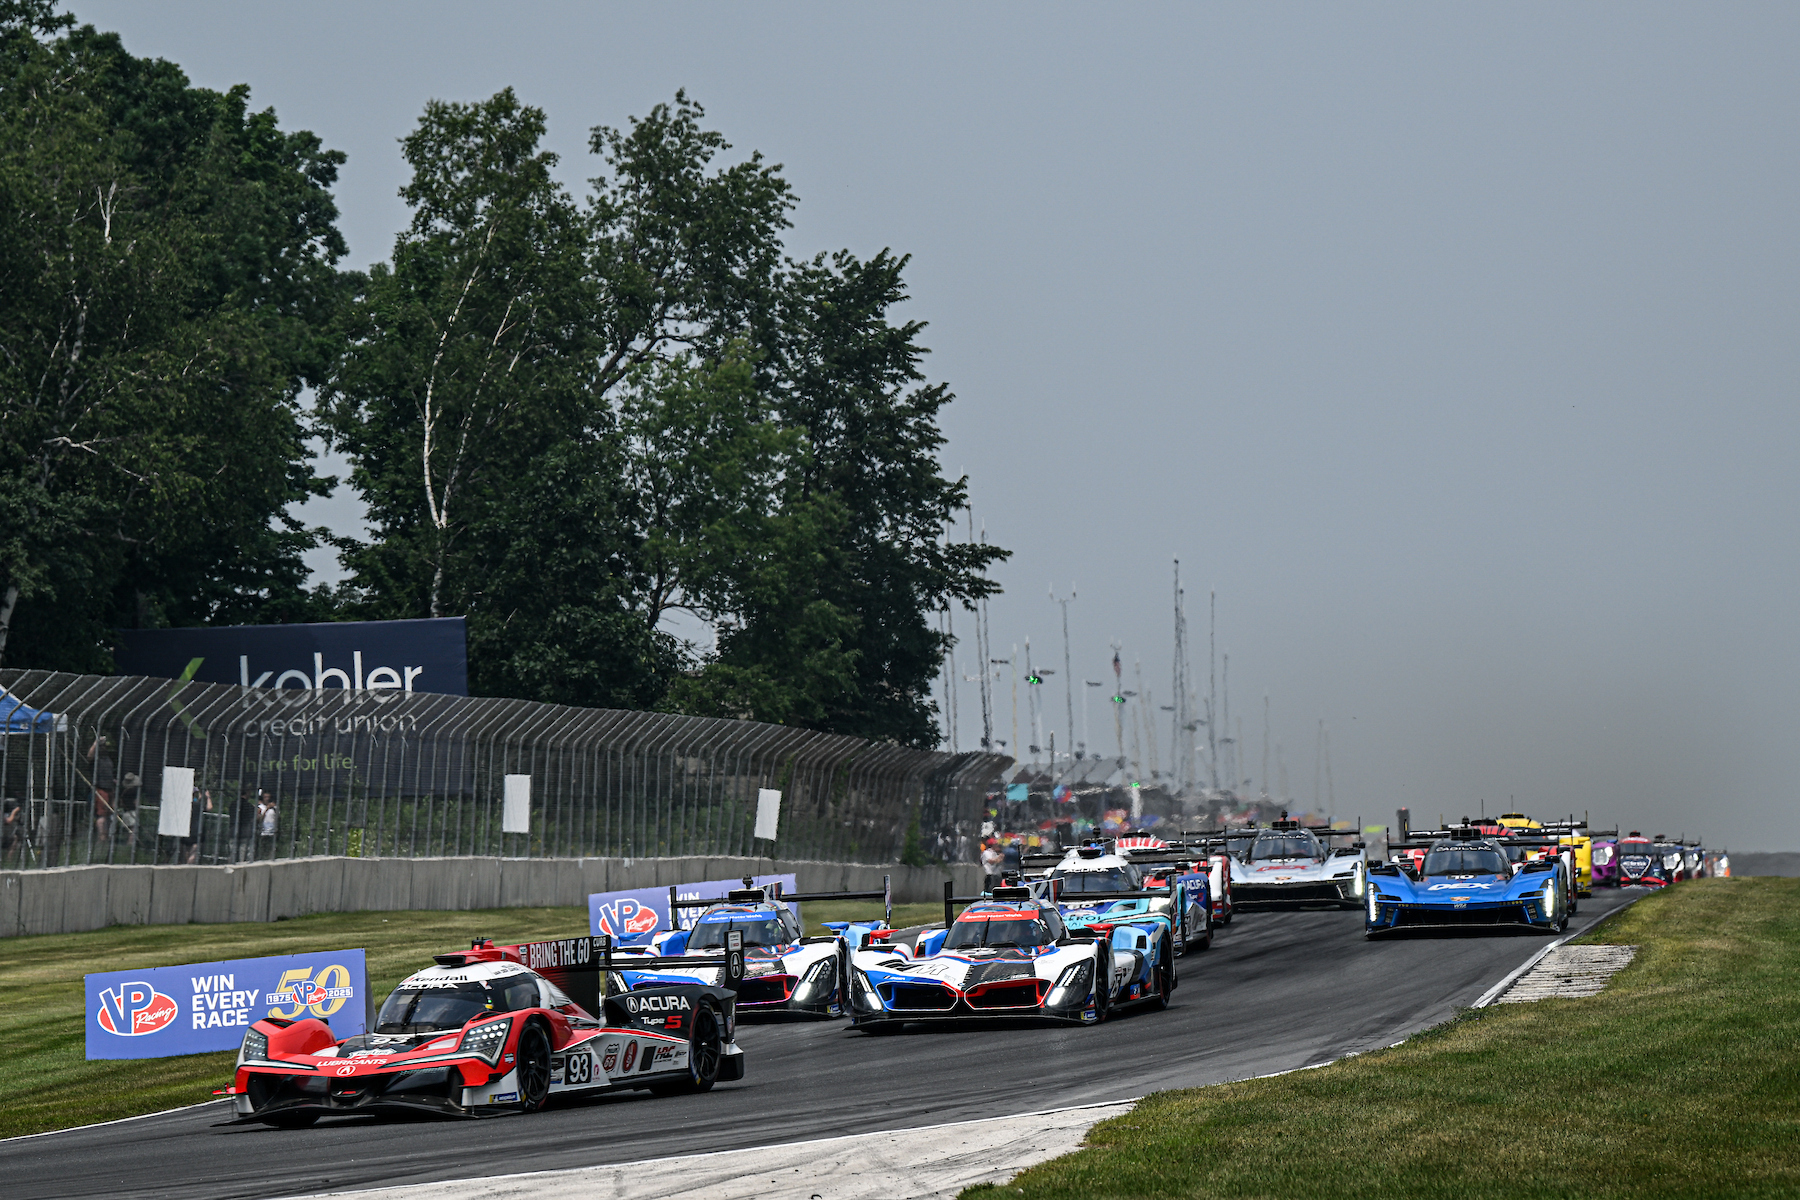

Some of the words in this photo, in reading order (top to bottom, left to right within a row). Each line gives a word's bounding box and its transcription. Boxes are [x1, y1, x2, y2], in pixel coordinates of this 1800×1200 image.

[240, 651, 423, 708] kohler
[245, 712, 327, 737] credit
[335, 713, 417, 735] union
[246, 756, 287, 772] here
[293, 754, 317, 771] for
[325, 753, 358, 770] life.
[1427, 882, 1494, 891] DEX
[599, 898, 640, 940] VP
[627, 916, 657, 932] Racing
[529, 941, 558, 969] BRING
[558, 939, 576, 966] THE
[577, 938, 590, 963] GO
[191, 974, 234, 993] WIN
[267, 965, 351, 1020] 50
[292, 981, 317, 1005] VP
[397, 983, 459, 991] ACURA
[192, 989, 260, 1012] EVERY
[268, 994, 291, 1003] 1975
[328, 988, 351, 997] 2025
[640, 996, 691, 1011] ACURA
[99, 981, 154, 1036] VP
[135, 1006, 177, 1029] Racing
[192, 1008, 250, 1029] RACE
[641, 1016, 665, 1026] Type
[664, 1015, 683, 1030] S
[316, 1059, 388, 1067] LUBRICANTS
[570, 1053, 589, 1083] 93
[604, 1056, 616, 1069] 66
